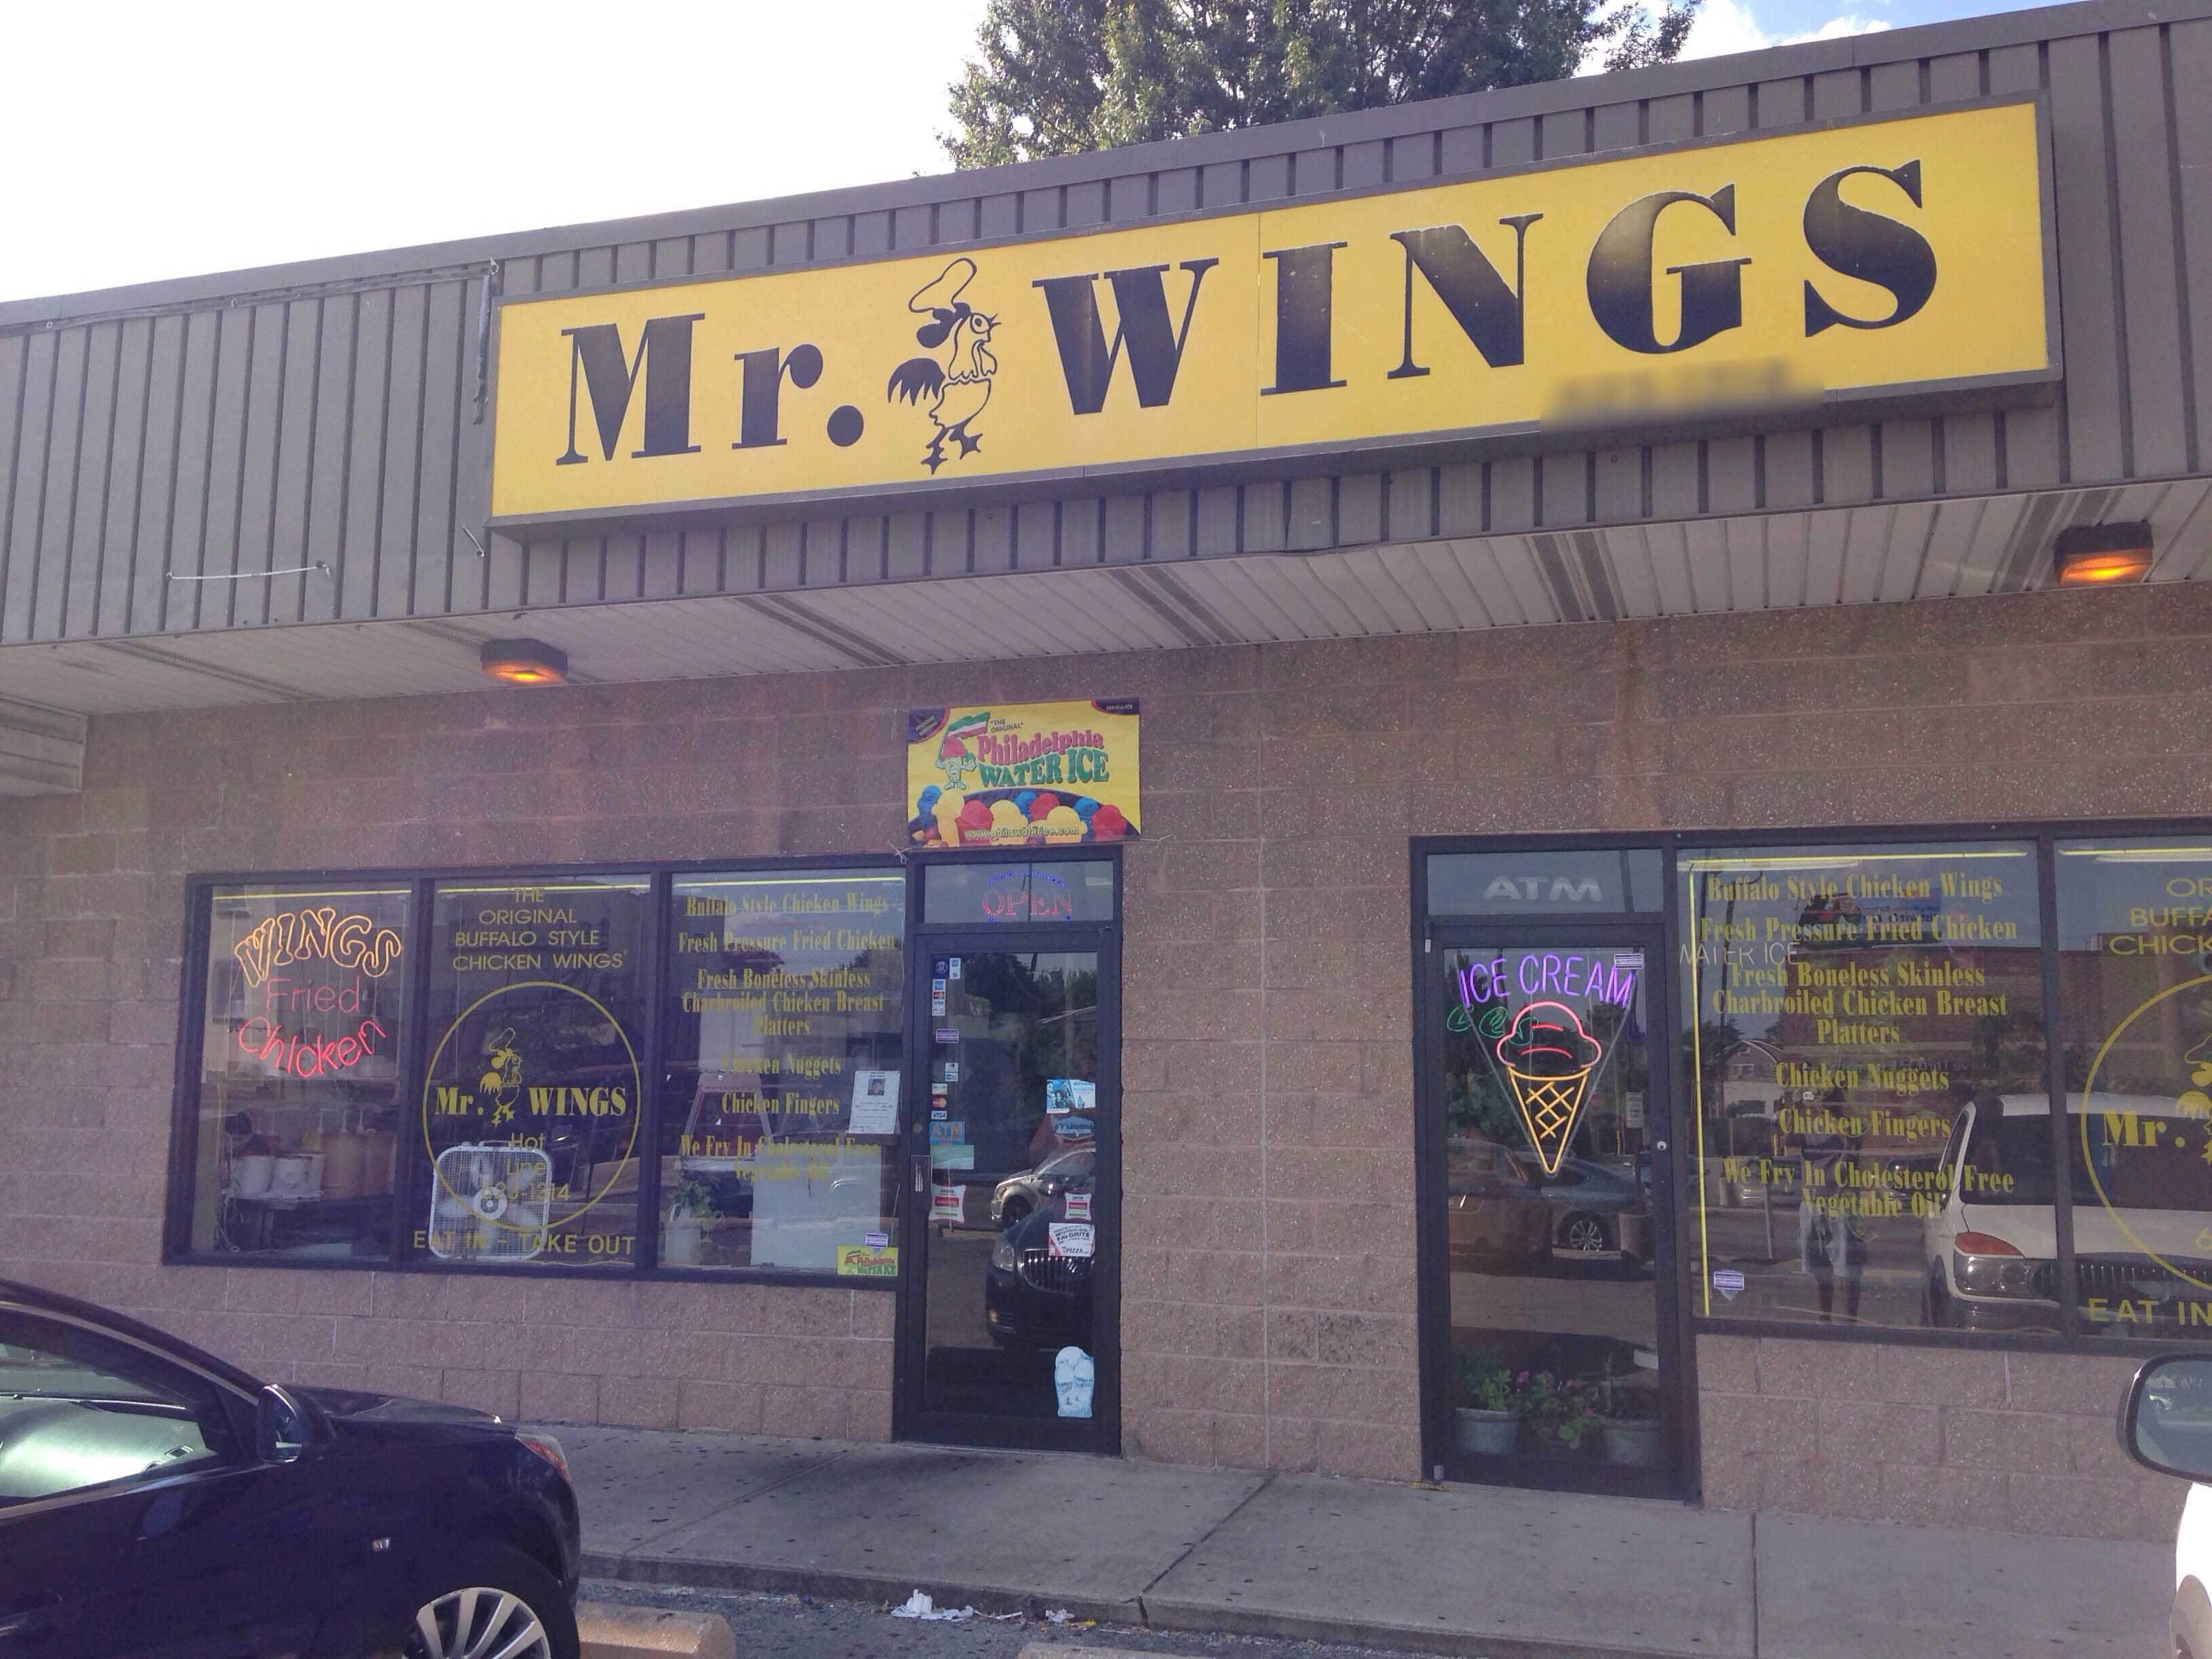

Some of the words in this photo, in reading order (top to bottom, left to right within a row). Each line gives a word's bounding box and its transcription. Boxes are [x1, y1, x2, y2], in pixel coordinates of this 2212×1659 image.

[556, 312, 864, 466] Mr.
[1031, 159, 1937, 416] WINGS
[976, 730, 1105, 766] Philadelphia
[979, 754, 1063, 788] WATER
[1065, 747, 1109, 784] ICE
[513, 888, 545, 903] THE
[983, 889, 1073, 916] OPEN
[1483, 876, 1603, 902] ATM
[1707, 875, 1780, 901] Buffalo
[1787, 873, 1838, 906] Style
[1846, 873, 1930, 899] Chicken
[1940, 872, 2003, 905] Wings
[478, 909, 577, 924] ORIGINAL
[687, 895, 737, 916] Buffalo
[743, 894, 776, 916] Style
[782, 893, 840, 913] Chicken
[846, 892, 889, 917] Wings
[455, 930, 537, 947] BUFFALO
[548, 930, 600, 946] STYLE
[678, 932, 718, 953] Fresh
[724, 930, 787, 952] Pressure
[792, 929, 830, 951] Fried
[836, 928, 895, 951] Chicken
[1700, 916, 1757, 942] Fresh
[1764, 916, 1858, 942] Pressure
[1866, 915, 1923, 941] Fried
[1931, 914, 2018, 941] Chicken
[234, 907, 402, 988] WINGS
[1764, 942, 1801, 966] ICE
[452, 954, 541, 970] CHICKEN
[1731, 961, 1788, 987] Fresh
[1797, 960, 1891, 987] Boneless
[1898, 960, 1985, 987] Skinless
[697, 968, 737, 989] Fresh
[743, 967, 806, 989] Boneless
[812, 966, 870, 988] Skinless
[1458, 958, 1511, 1009] ICE
[1518, 954, 1635, 1009] CREAM
[265, 975, 361, 1013] Fried
[773, 991, 830, 1012] Chicken
[836, 990, 884, 1012] Breast
[1713, 988, 1835, 1015] Charbroiled
[1843, 989, 1928, 1016] Chicken
[1936, 990, 2008, 1016] Breast
[753, 1015, 811, 1036] Platters
[1817, 1019, 1901, 1044] Platters
[238, 1016, 386, 1078] Chicken
[786, 1052, 842, 1080] Nuggets
[1776, 1061, 1860, 1089] Chicken
[1868, 1062, 1950, 1096] Nuggets
[435, 1086, 485, 1115] Mr.
[528, 1086, 627, 1117] WINGS
[721, 1092, 779, 1114] Chicken
[785, 1092, 840, 1121] Fingers
[1778, 1107, 1864, 1135] Chicken
[1870, 1109, 1952, 1143] Fingers
[2103, 1108, 2186, 1147] Mr.
[510, 1132, 546, 1150] Hot
[680, 1134, 700, 1156] We
[705, 1134, 731, 1158] Fry
[737, 1135, 752, 1156] In
[506, 1159, 546, 1176] Line
[1723, 1158, 1752, 1184] We
[1760, 1160, 1796, 1192] Fry
[1804, 1160, 1826, 1186] In
[1834, 1160, 1954, 1191] Cholesterol
[1964, 1165, 2014, 1193] Free
[1801, 1187, 1903, 1218] Vegetable
[1910, 1191, 1941, 1218] Oil
[519, 1232, 577, 1253] TAKE
[588, 1235, 636, 1255] OUT
[2087, 1297, 2160, 1324] EAT
[2177, 1300, 2212, 1326] IN
